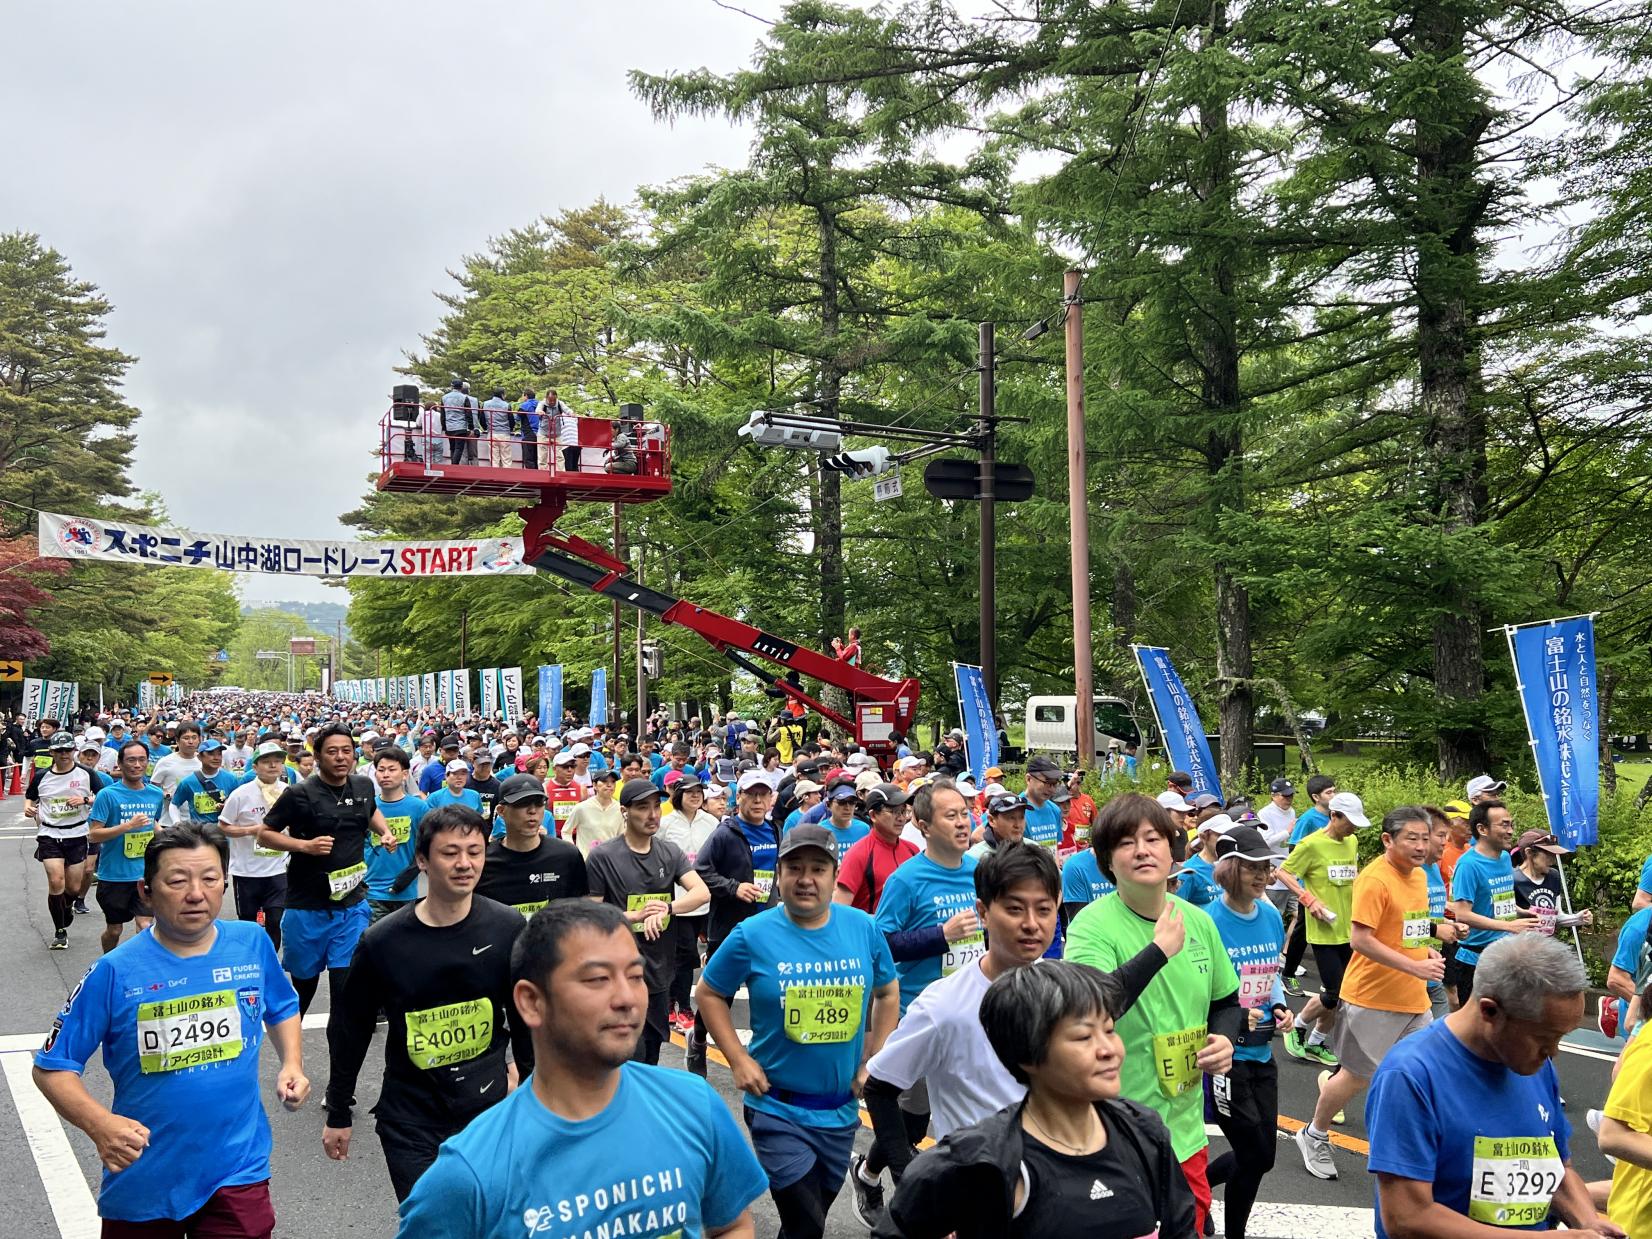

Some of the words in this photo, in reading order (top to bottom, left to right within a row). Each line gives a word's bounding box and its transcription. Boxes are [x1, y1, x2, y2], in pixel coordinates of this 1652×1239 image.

[103, 529, 397, 575] スポニチ山中湖ロードレース
[401, 547, 478, 575] START
[1575, 632, 1592, 741] 水と人と自然をつなぐ
[796, 958, 861, 974] SPONICHI
[947, 953, 954, 966] D
[798, 988, 853, 998] 富士山の銘水
[1243, 982, 1250, 994] D
[153, 995, 225, 1018] 富士山の銘水
[418, 1003, 480, 1024] 富士山の銘水
[790, 1009, 800, 1024] D
[815, 1008, 849, 1024] 489
[144, 1031, 158, 1050] D
[170, 1018, 230, 1047] 2496
[1163, 1059, 1174, 1077] E
[1492, 1142, 1551, 1157] 富士山の銘水
[1481, 1171, 1495, 1196] E
[1507, 1172, 1556, 1196] 3292
[557, 1167, 683, 1223] SPONICHI
